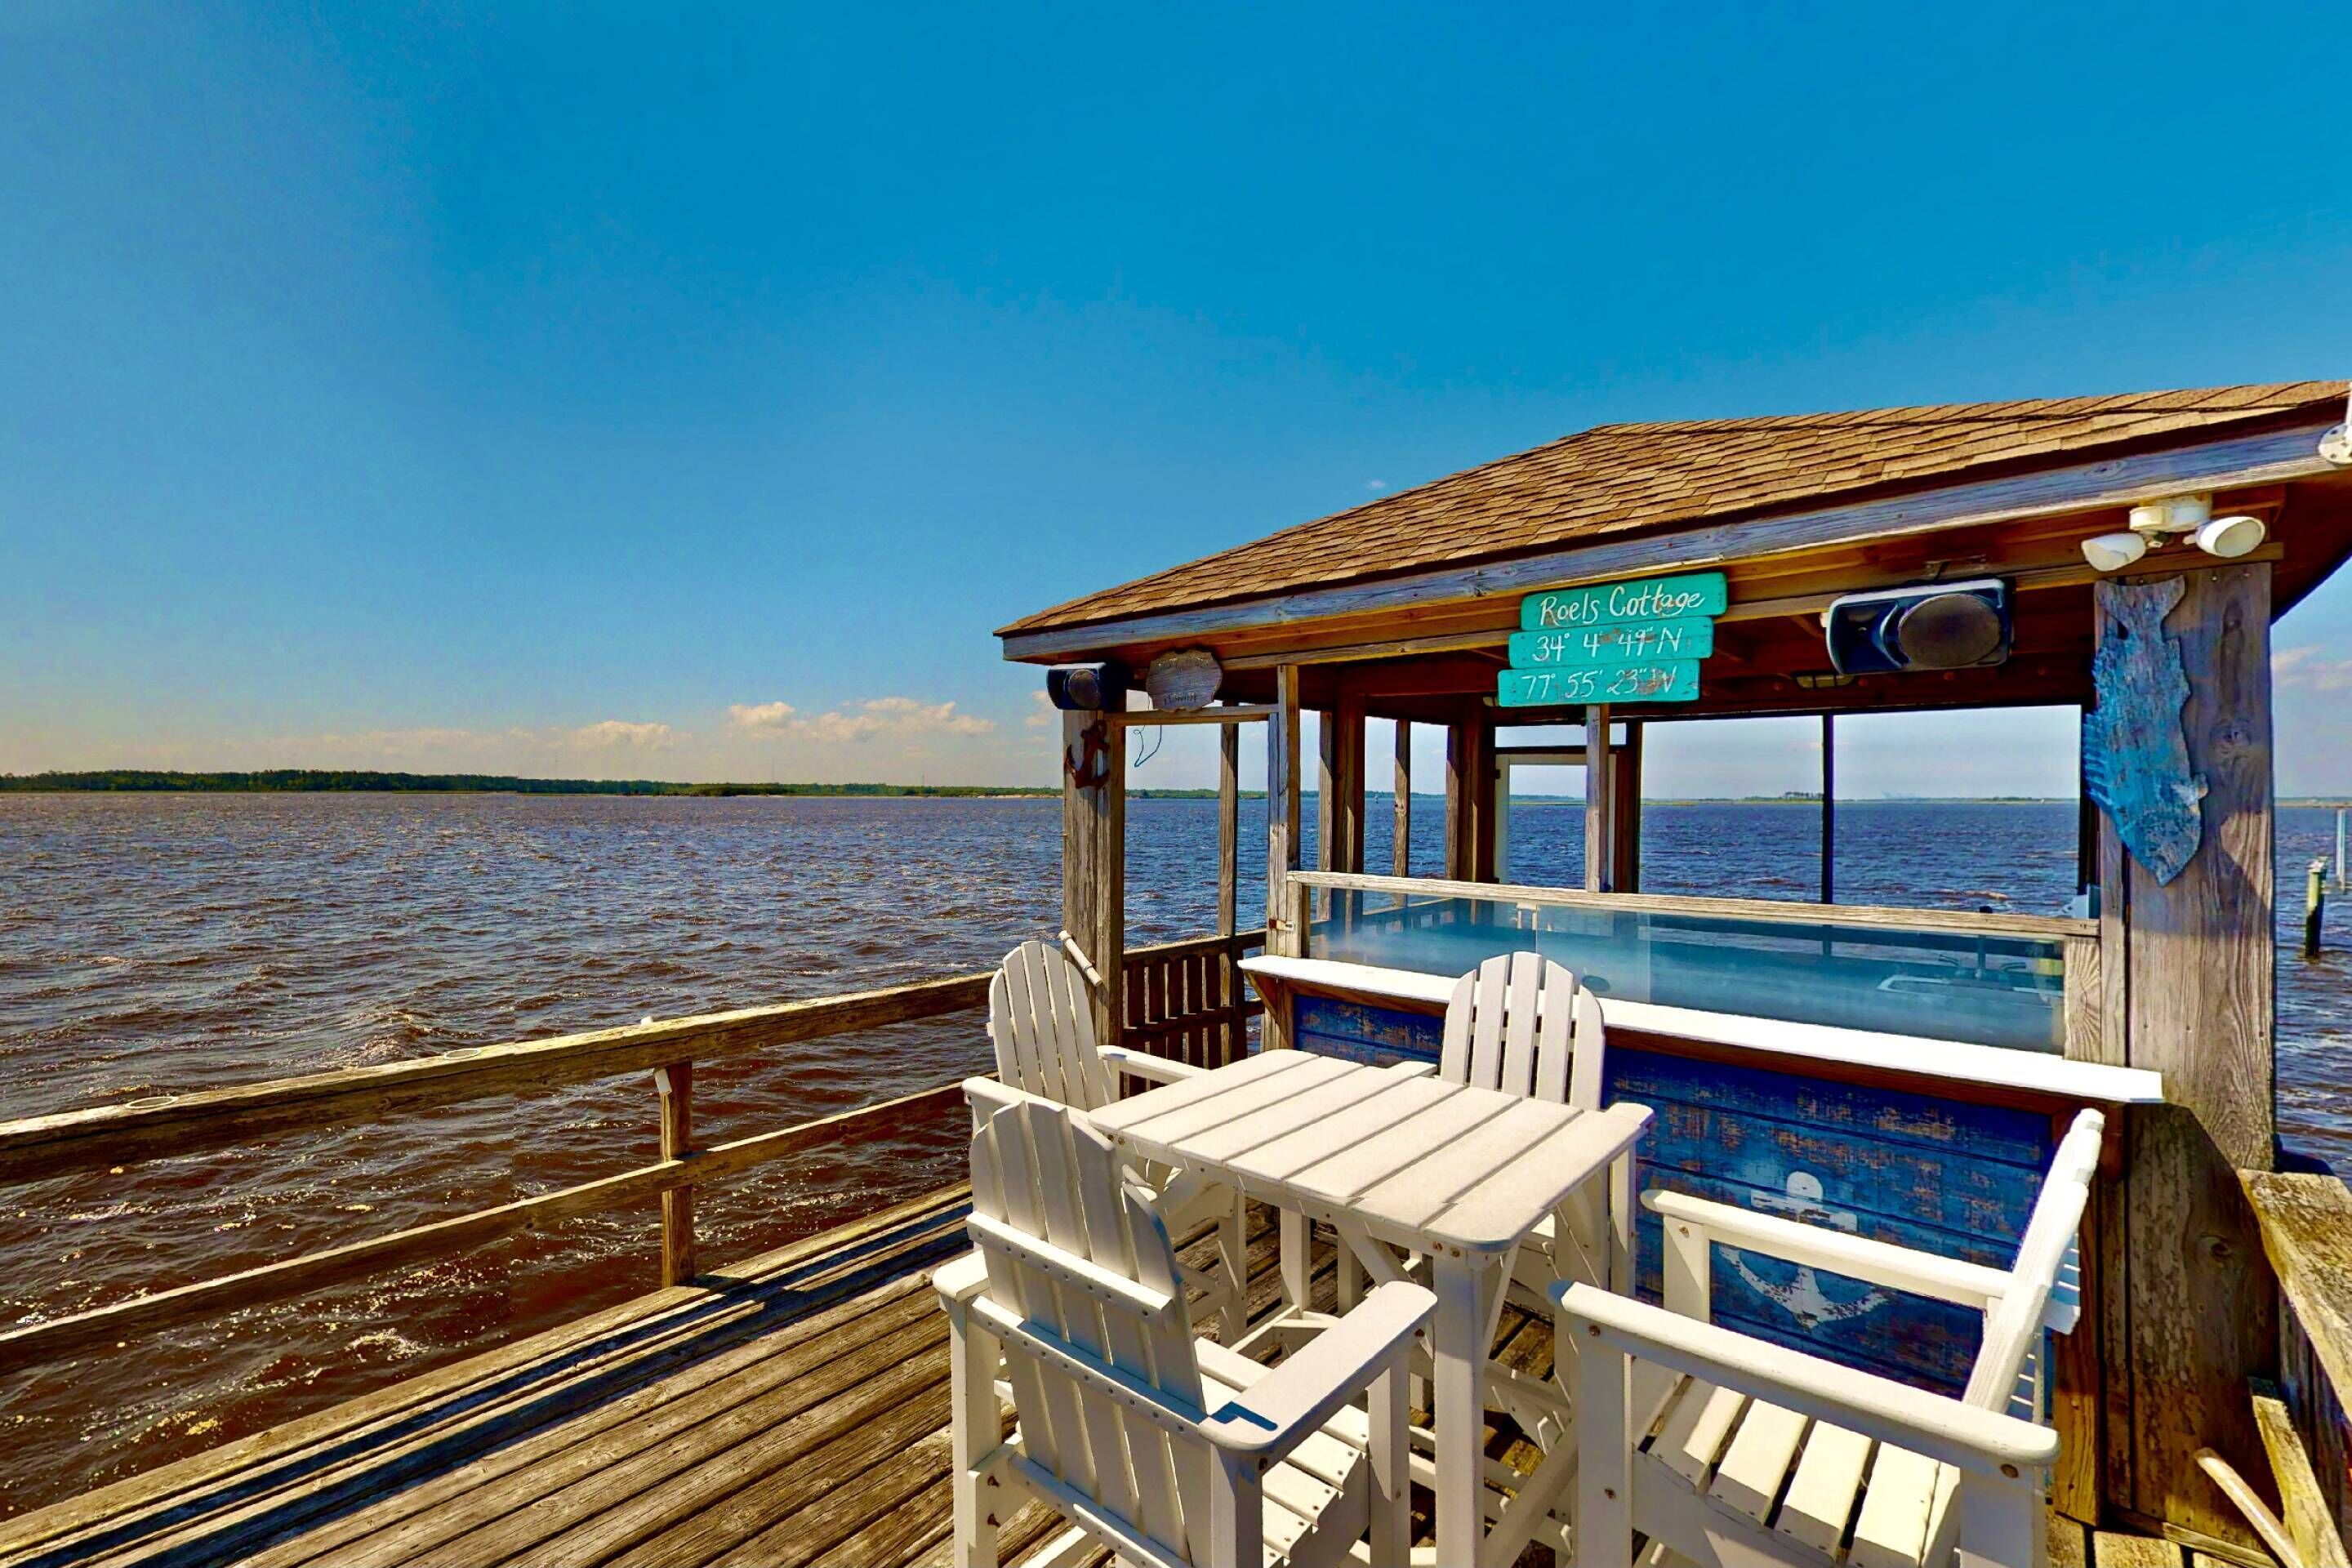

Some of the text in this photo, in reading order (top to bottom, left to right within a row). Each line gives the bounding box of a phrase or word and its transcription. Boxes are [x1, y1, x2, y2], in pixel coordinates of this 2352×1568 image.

[1539, 583, 1706, 627] Roels Cottage
[1656, 626, 1683, 654] N
